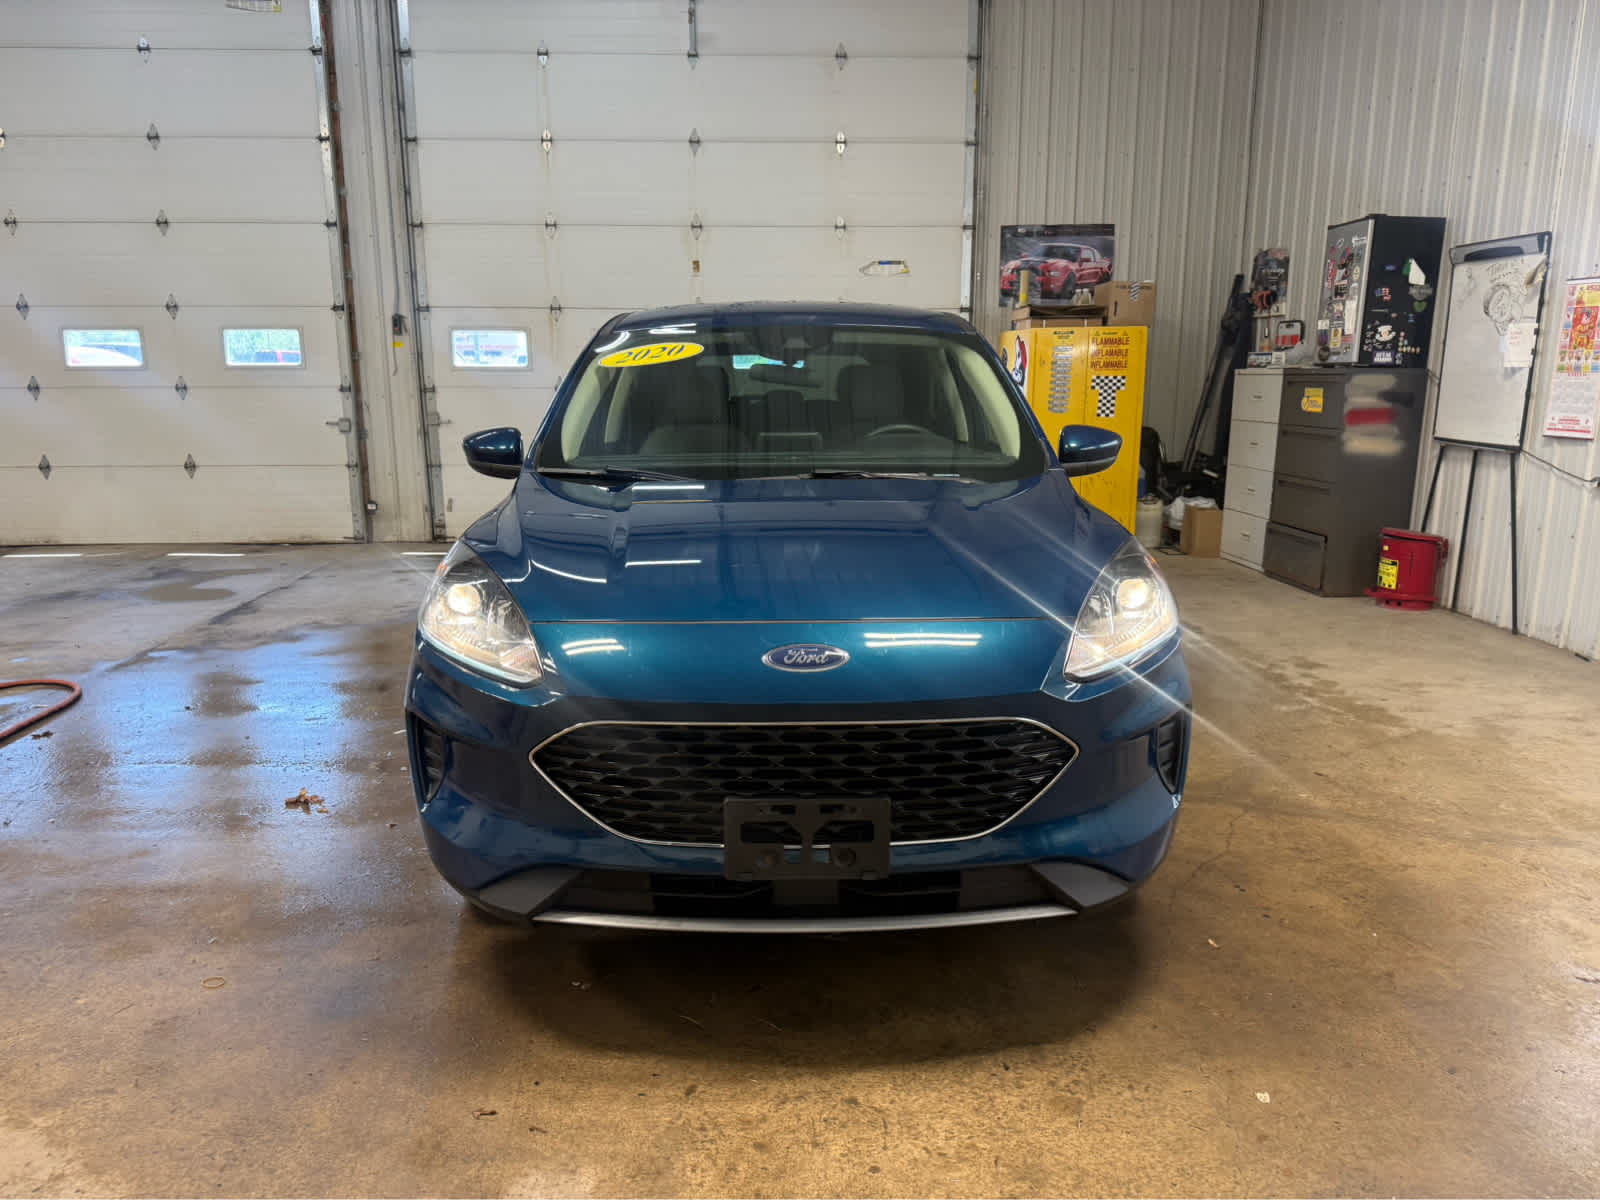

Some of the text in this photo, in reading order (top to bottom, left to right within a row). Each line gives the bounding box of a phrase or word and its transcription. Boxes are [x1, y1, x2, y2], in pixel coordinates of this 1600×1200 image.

[1091, 336, 1130, 346] FLAMMABLE
[616, 344, 685, 363] 2020
[783, 648, 830, 665] Ford
